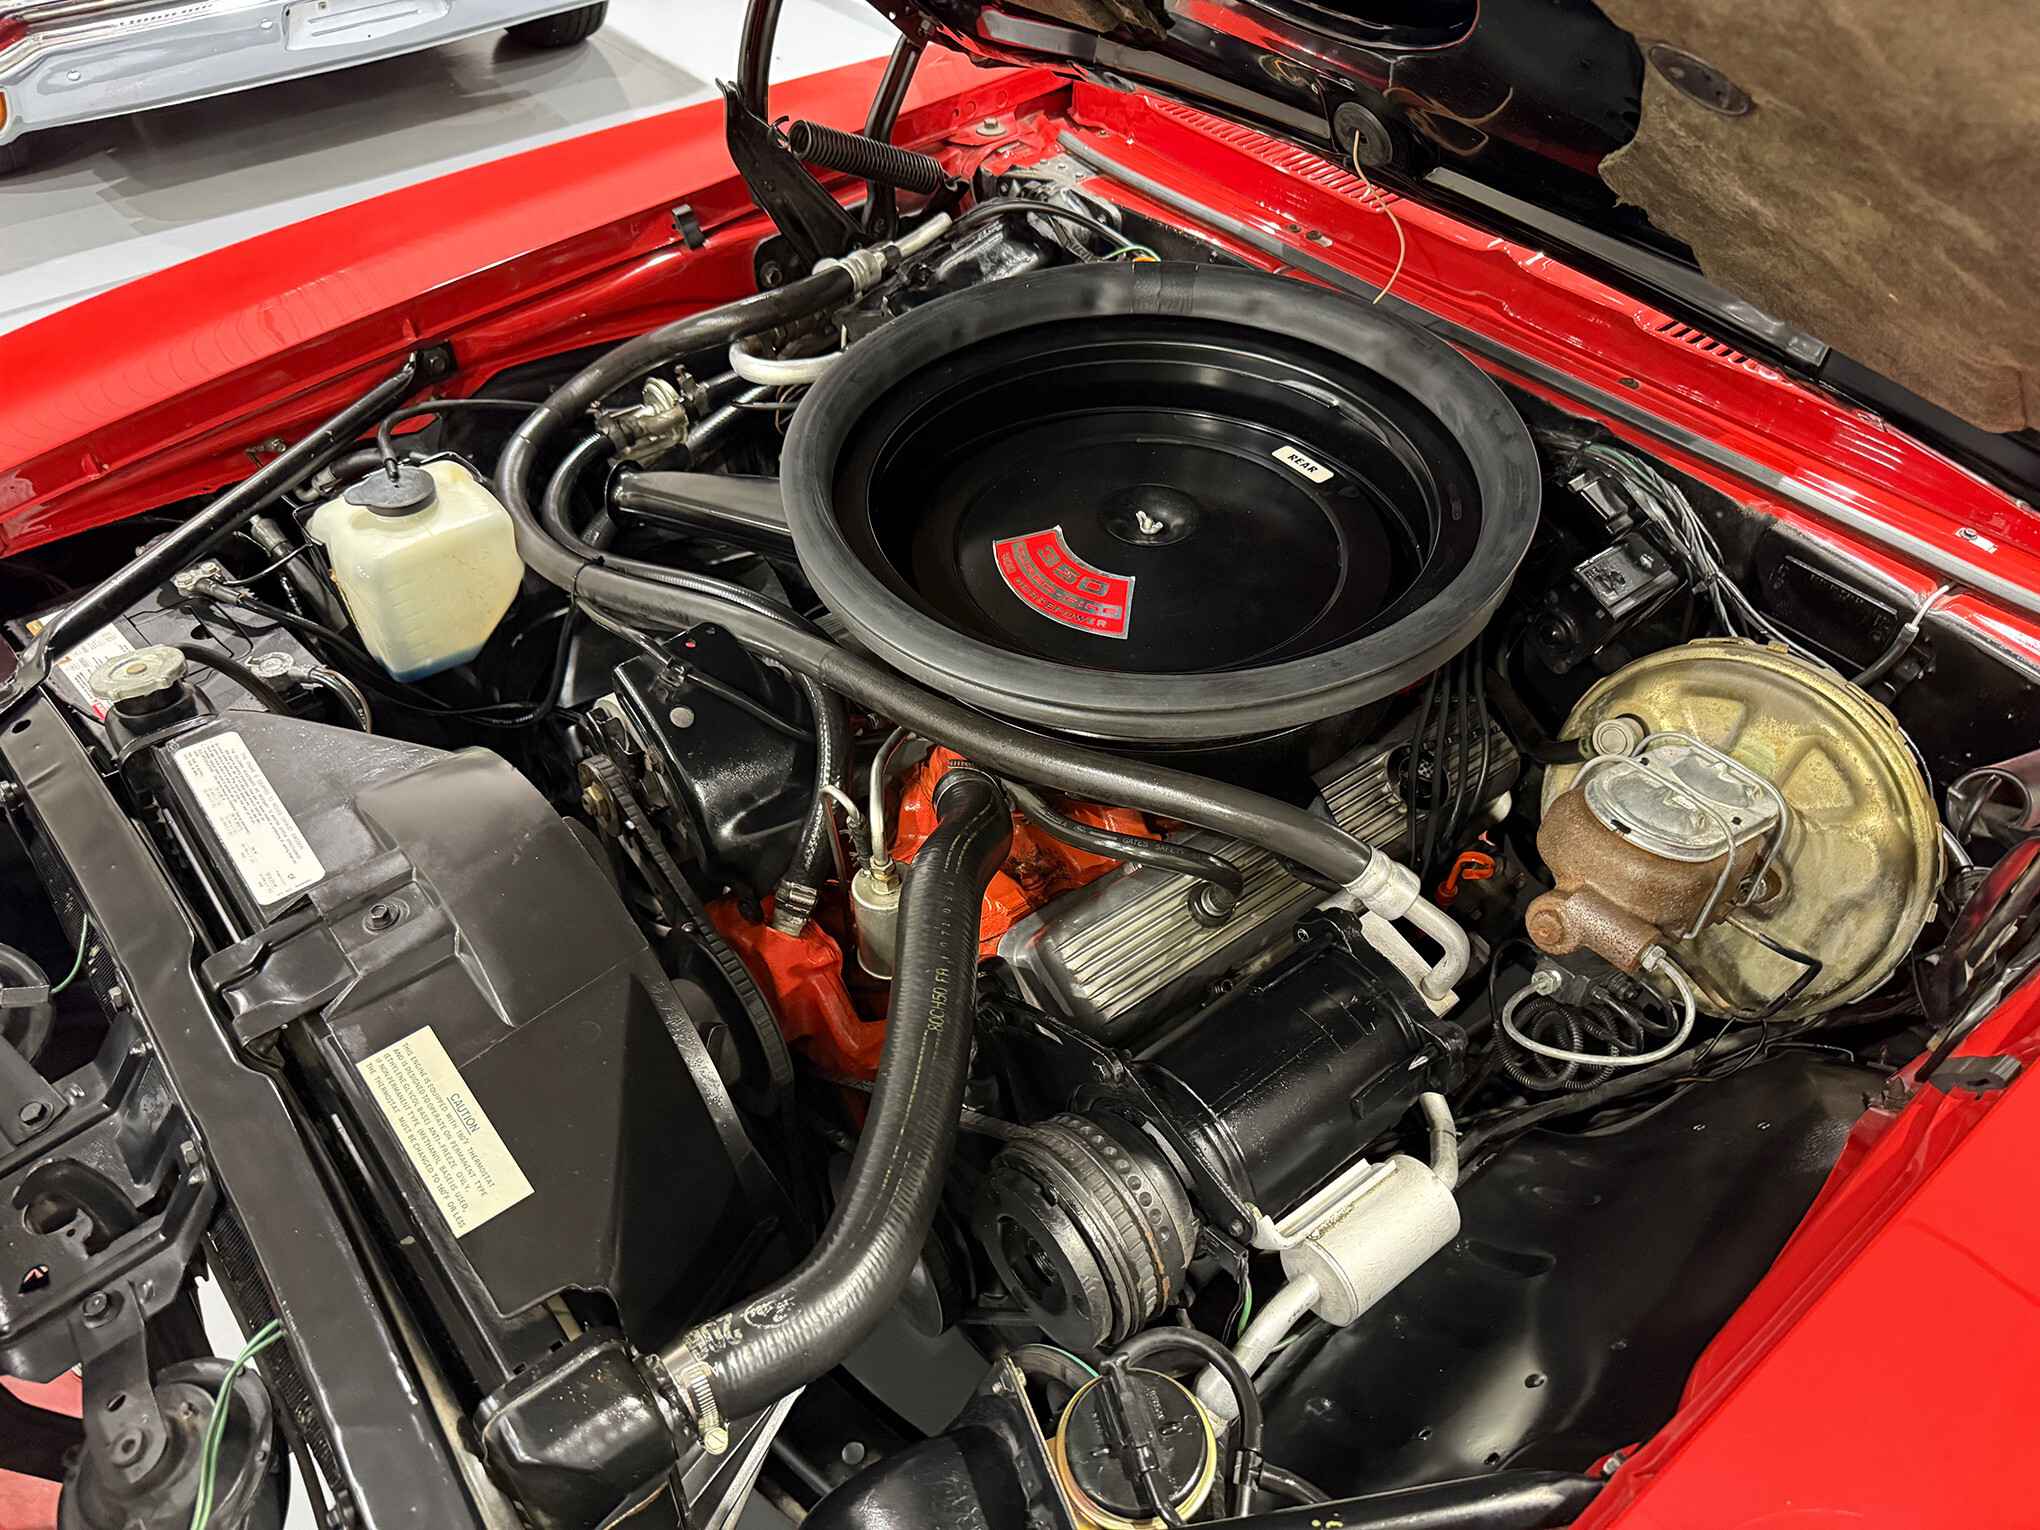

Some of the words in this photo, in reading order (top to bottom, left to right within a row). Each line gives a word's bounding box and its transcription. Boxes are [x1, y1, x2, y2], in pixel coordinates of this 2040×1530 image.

[1287, 454, 1318, 473] REAR
[1017, 544, 1119, 616] TURBO-FIRE
[1037, 545, 1110, 596] 350
[1015, 577, 1107, 627] HORSEPOWER
[1122, 836, 1148, 848] GATES
[1154, 843, 1184, 855] SAFETY
[926, 987, 948, 1032] 80CH50
[392, 1047, 405, 1061] AND
[401, 1042, 413, 1056] THIS
[364, 1061, 376, 1075] THE
[374, 1056, 383, 1064] IF
[400, 1059, 408, 1067] IS
[409, 1055, 427, 1078] ENGINE
[378, 1063, 390, 1077] NON
[403, 1065, 426, 1095] DESIGNED
[422, 1076, 431, 1084] IS
[372, 1075, 400, 1114] THERMOSTAT
[385, 1075, 411, 1112] PERMANENT
[421, 1094, 431, 1104] TO
[426, 1083, 448, 1112] EQUIPPED
[406, 1110, 420, 1127] TYPE
[425, 1101, 447, 1130] OPERATE
[444, 1111, 459, 1129] WITH
[448, 1092, 480, 1133] CAUTION
[396, 1116, 411, 1134] MUST
[401, 1082, 420, 1107] GLYCOL
[427, 1124, 458, 1169] ANTI-FREEZE
[406, 1133, 417, 1143] BE
[442, 1129, 453, 1141] ON
[411, 1141, 435, 1174] CHANGED
[449, 1139, 477, 1179] PERMANENT
[466, 1146, 495, 1188] THERMOSTAT
[430, 1172, 441, 1184] TO
[473, 1179, 488, 1197] TYPE
[446, 1200, 457, 1212] OR
[452, 1210, 467, 1229] LESS
